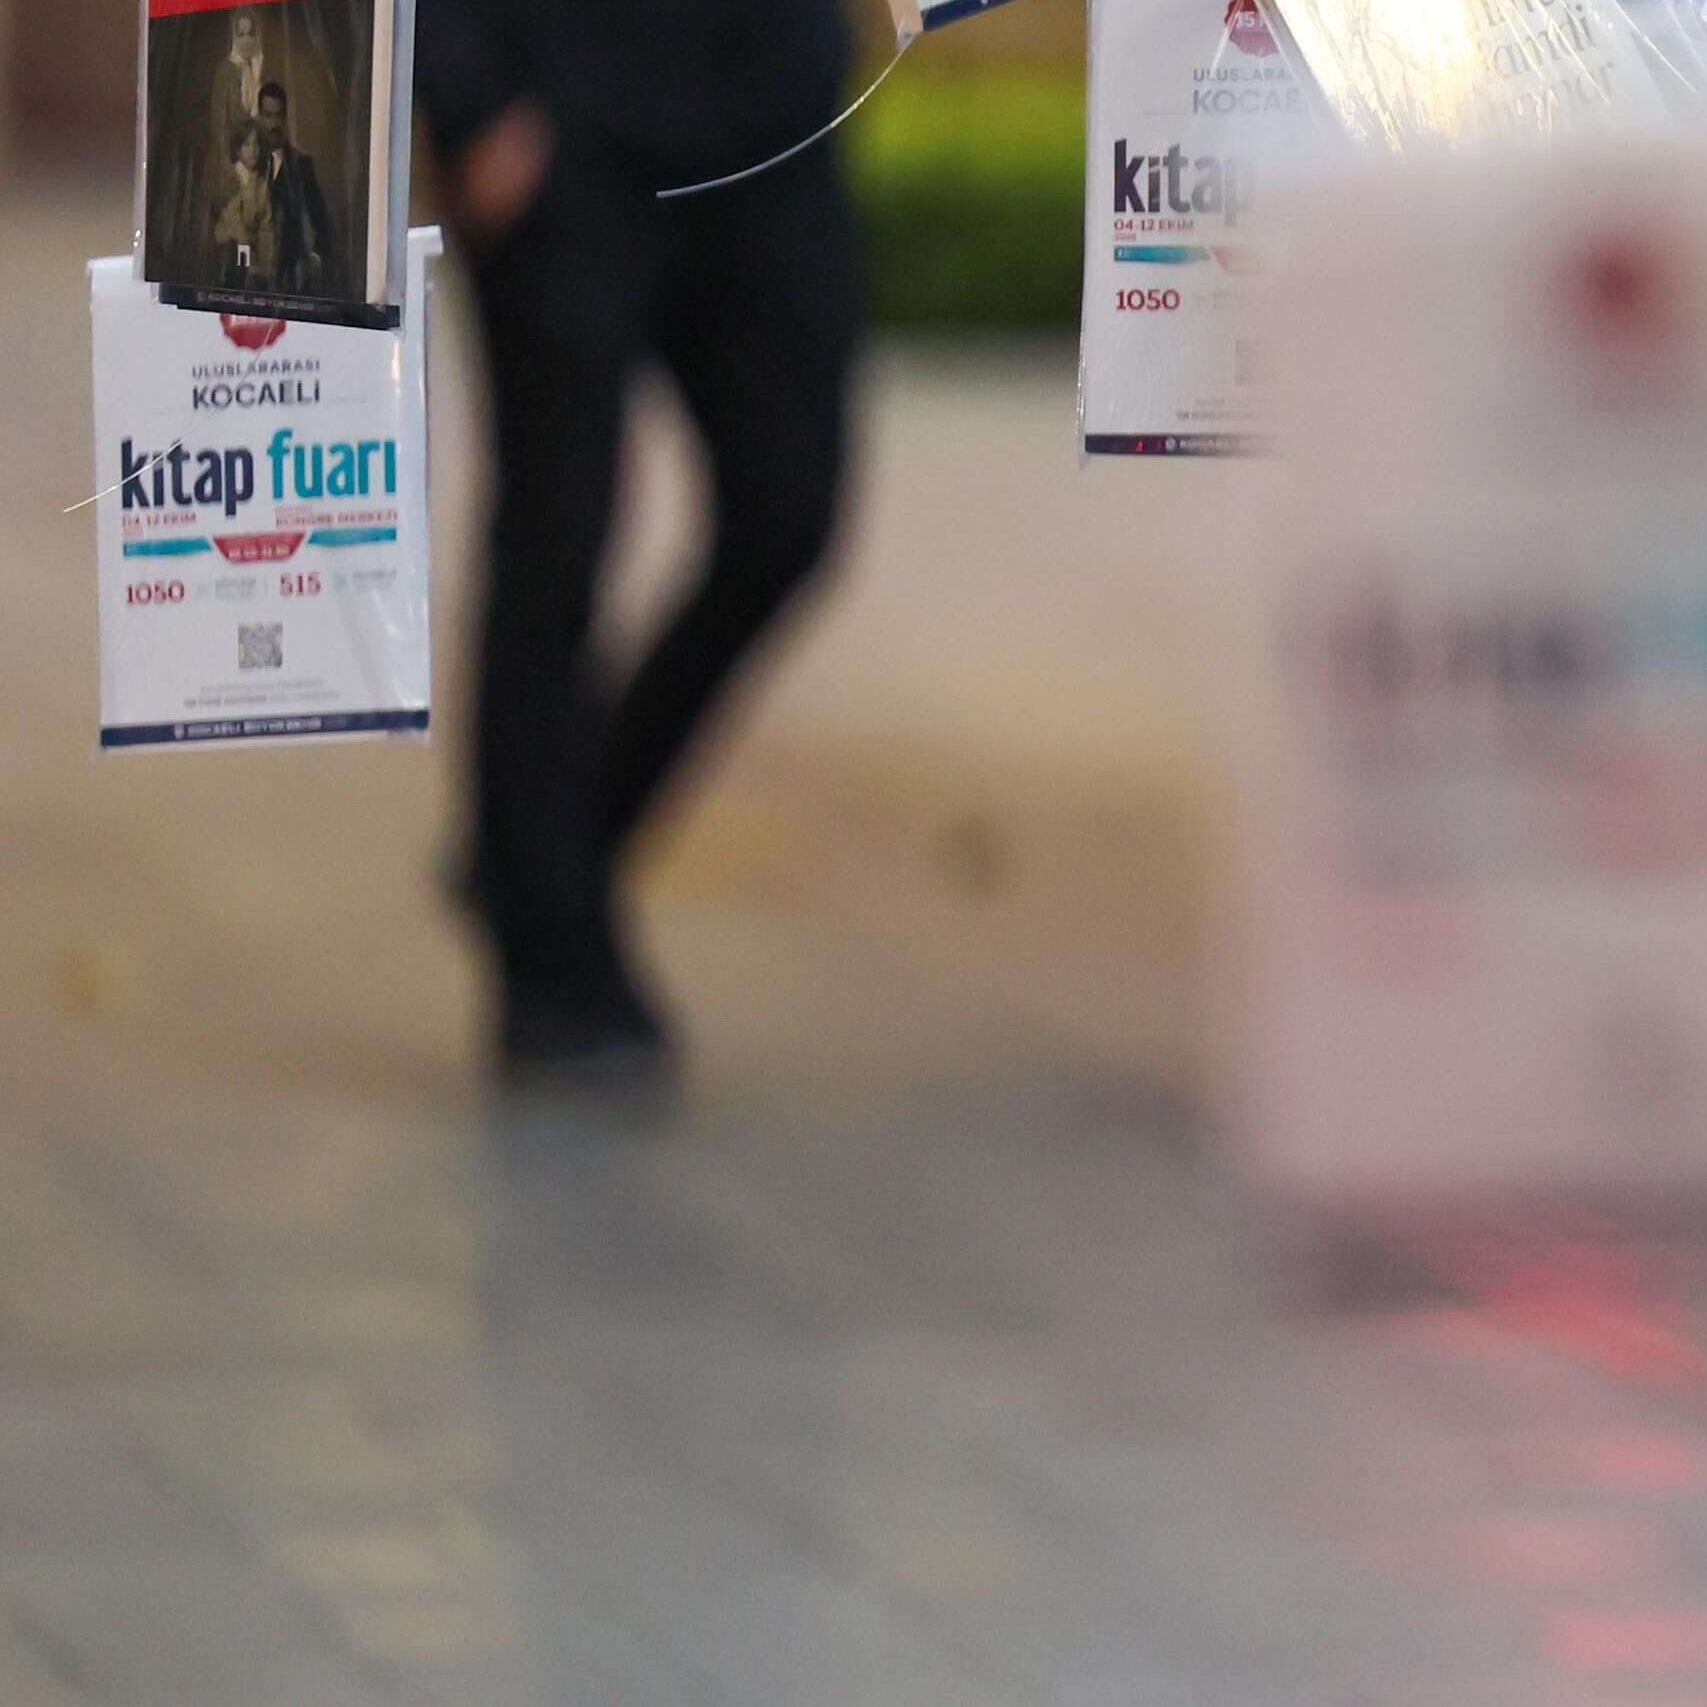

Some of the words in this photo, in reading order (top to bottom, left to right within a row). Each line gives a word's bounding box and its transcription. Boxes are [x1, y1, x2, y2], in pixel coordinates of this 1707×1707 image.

[1113, 138, 1255, 228] kitap
[1115, 289, 1181, 312] 1050
[192, 378, 321, 410] KOCAELİ
[121, 437, 253, 517] kitap
[266, 428, 395, 500] fuarı
[126, 579, 185, 606] 1050
[279, 571, 321, 597] 515
